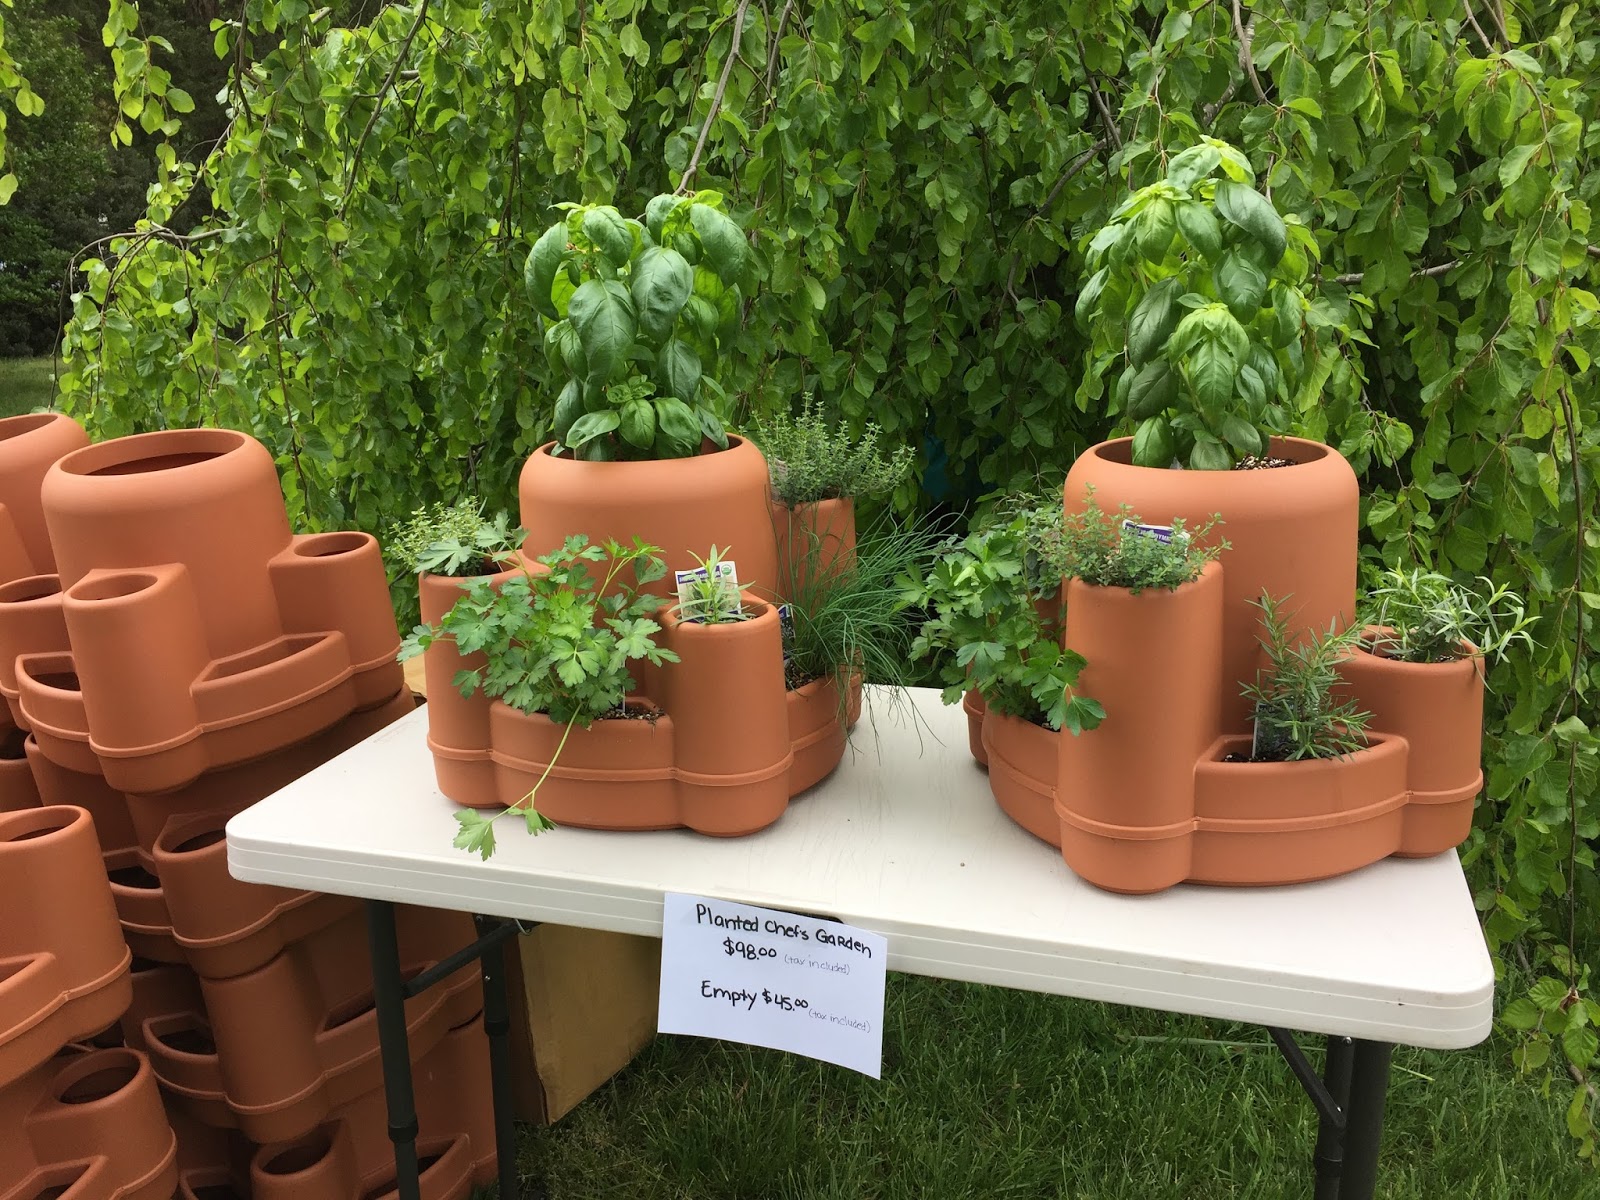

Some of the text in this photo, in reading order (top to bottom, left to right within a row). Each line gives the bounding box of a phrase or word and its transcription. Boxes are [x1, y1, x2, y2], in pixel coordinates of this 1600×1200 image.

[696, 904, 759, 932] Planted
[765, 920, 809, 941] Chef's
[723, 937, 850, 975] $98.00 (tax included)
[701, 980, 871, 1033] Empty $45.00 (tax included)
